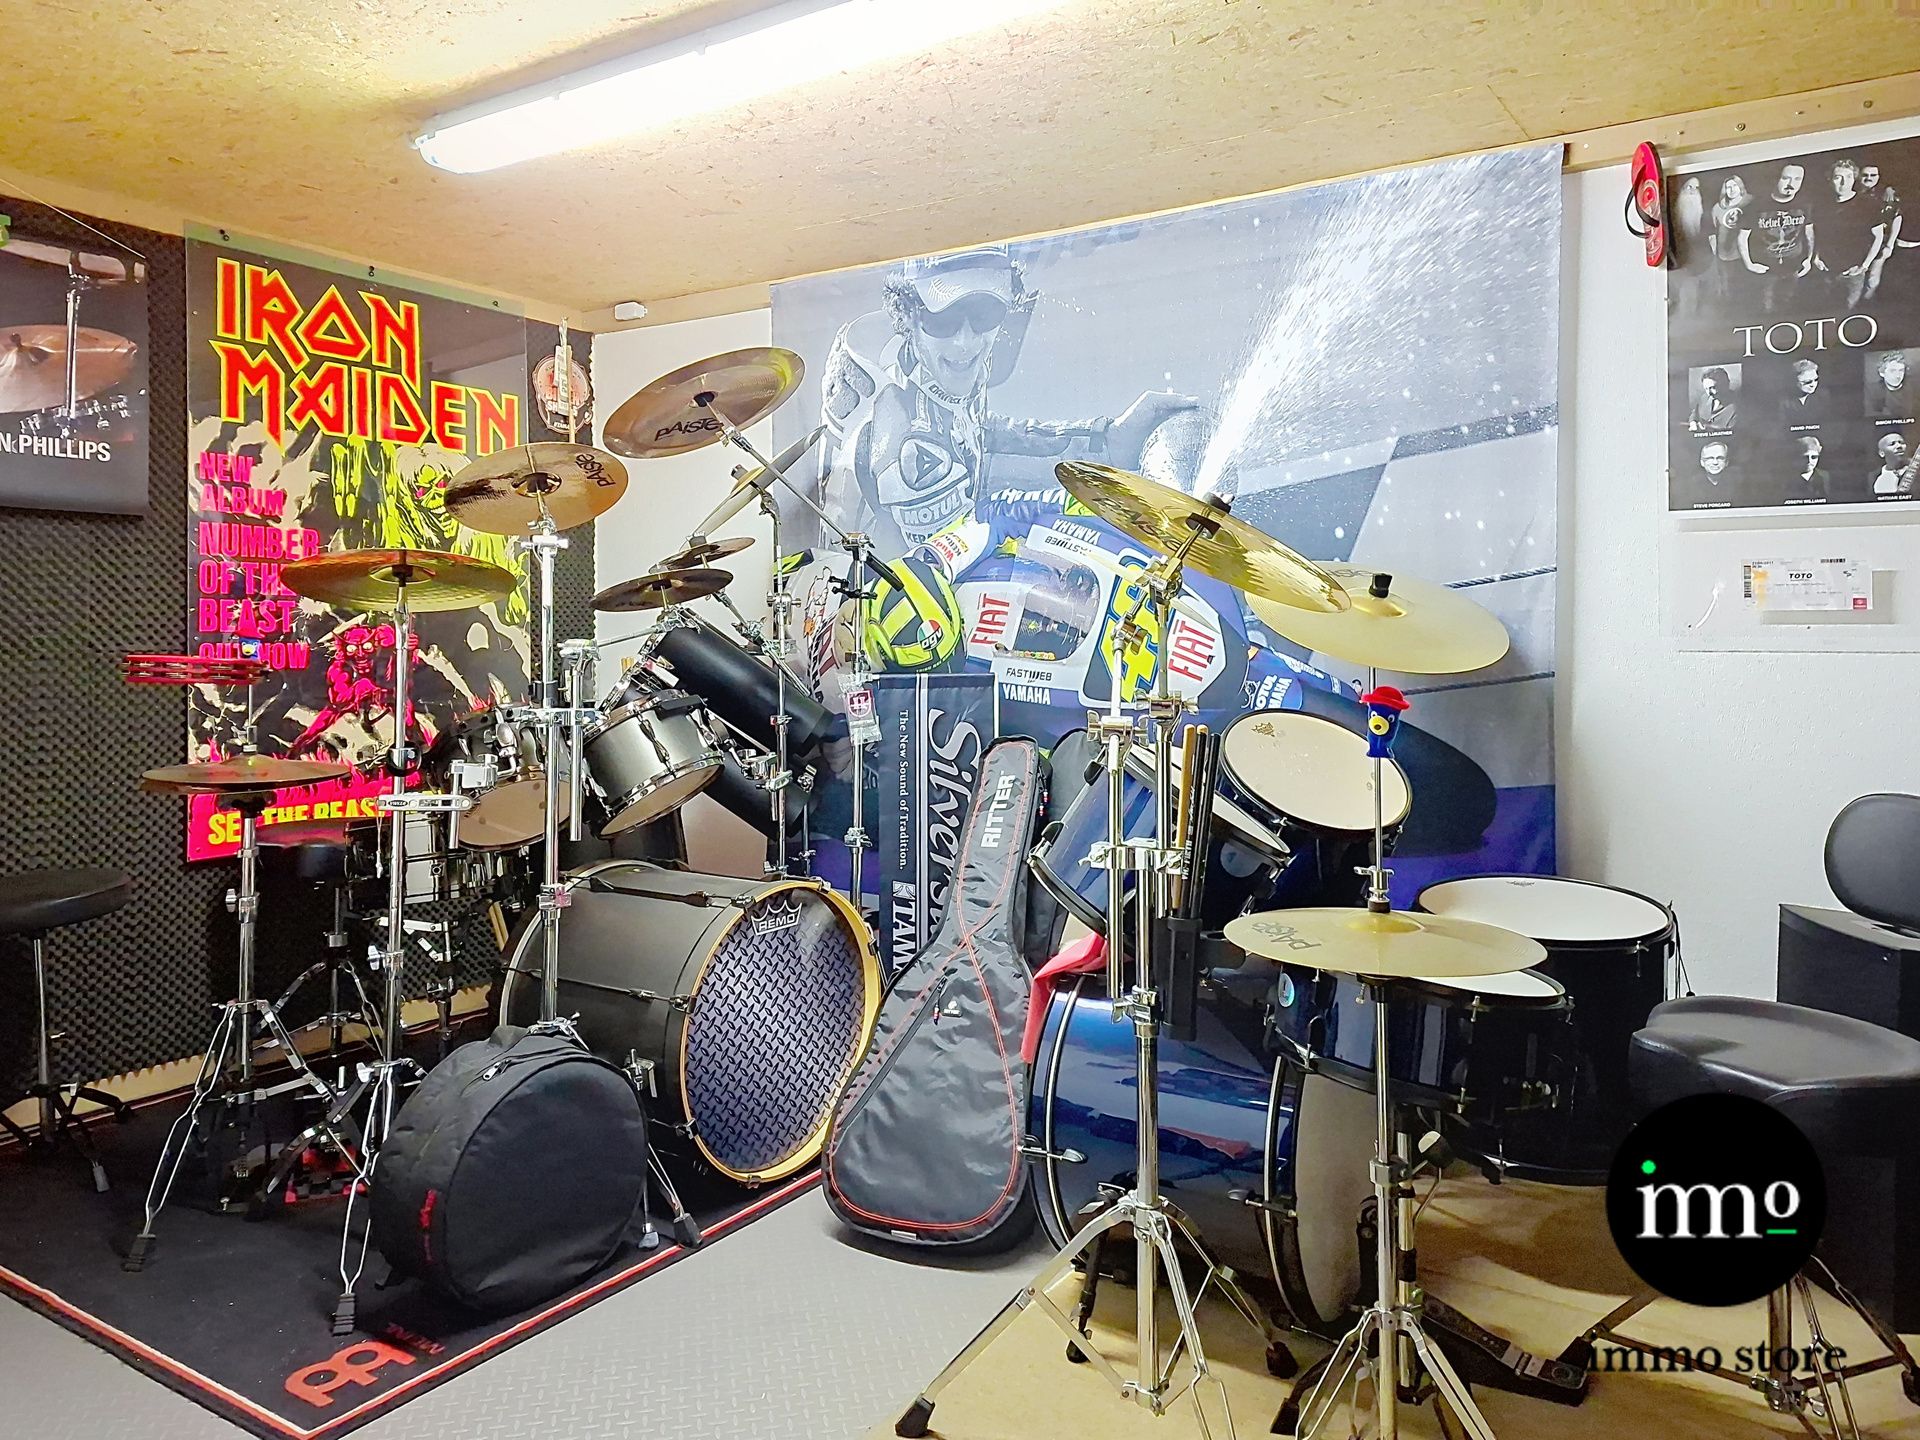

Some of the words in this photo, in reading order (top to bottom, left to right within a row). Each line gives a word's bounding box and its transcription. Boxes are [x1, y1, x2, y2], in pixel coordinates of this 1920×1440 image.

[216, 257, 421, 398] IRON
[1733, 315, 1878, 357] TOTO
[208, 340, 519, 457] MAIDEN
[19, 434, 111, 462] PHILLIPS
[199, 451, 254, 484] NEW
[199, 483, 284, 516] ALBUM
[904, 491, 960, 525] MOTUL
[199, 521, 320, 560] NUMBER
[1051, 519, 1101, 545] YAMAHA
[199, 560, 236, 595] OF
[199, 598, 297, 633] BEAST
[970, 593, 1010, 645] FIAT
[1168, 620, 1215, 682] FIAT
[1002, 683, 1051, 705] YAMAHA
[1268, 677, 1293, 708] MAHA
[899, 709, 909, 731] The
[899, 734, 909, 759] New
[899, 760, 909, 799] Sound
[208, 811, 242, 845] SE
[314, 797, 384, 820] BEAS
[899, 801, 909, 813] of
[981, 774, 1016, 848] RITTER
[899, 813, 909, 870] Tradition.
[758, 913, 795, 931] REMO
